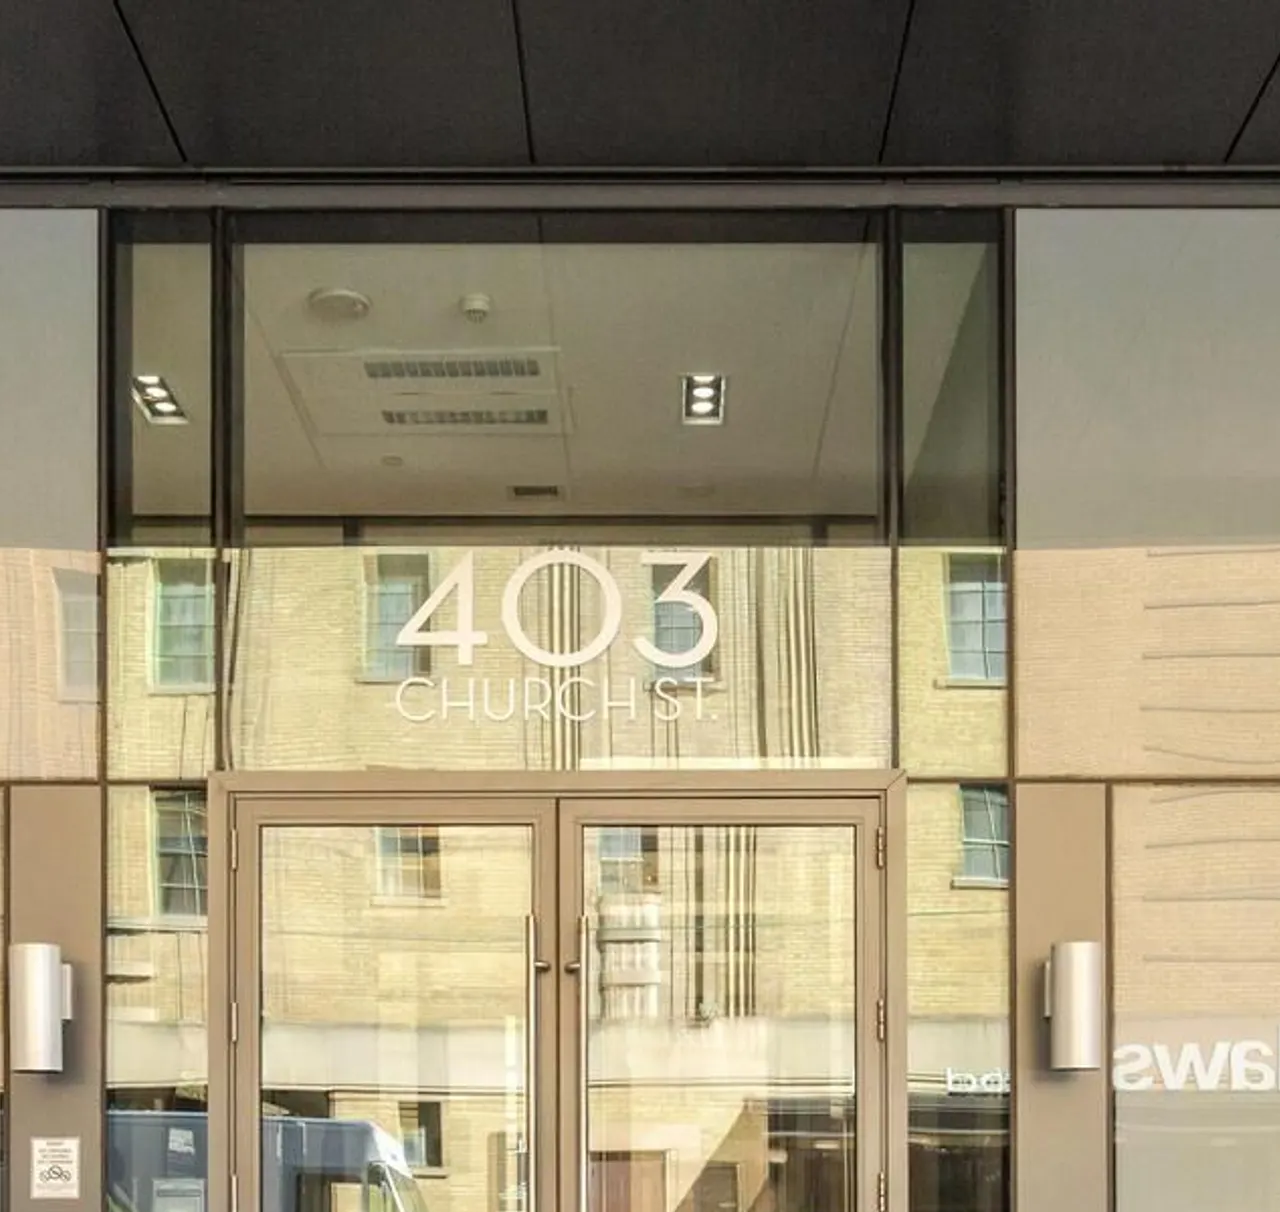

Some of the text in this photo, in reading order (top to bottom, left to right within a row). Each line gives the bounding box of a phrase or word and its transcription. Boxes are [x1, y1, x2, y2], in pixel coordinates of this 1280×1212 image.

[395, 549, 719, 668] 403
[394, 676, 718, 721] CHURCH ST.
